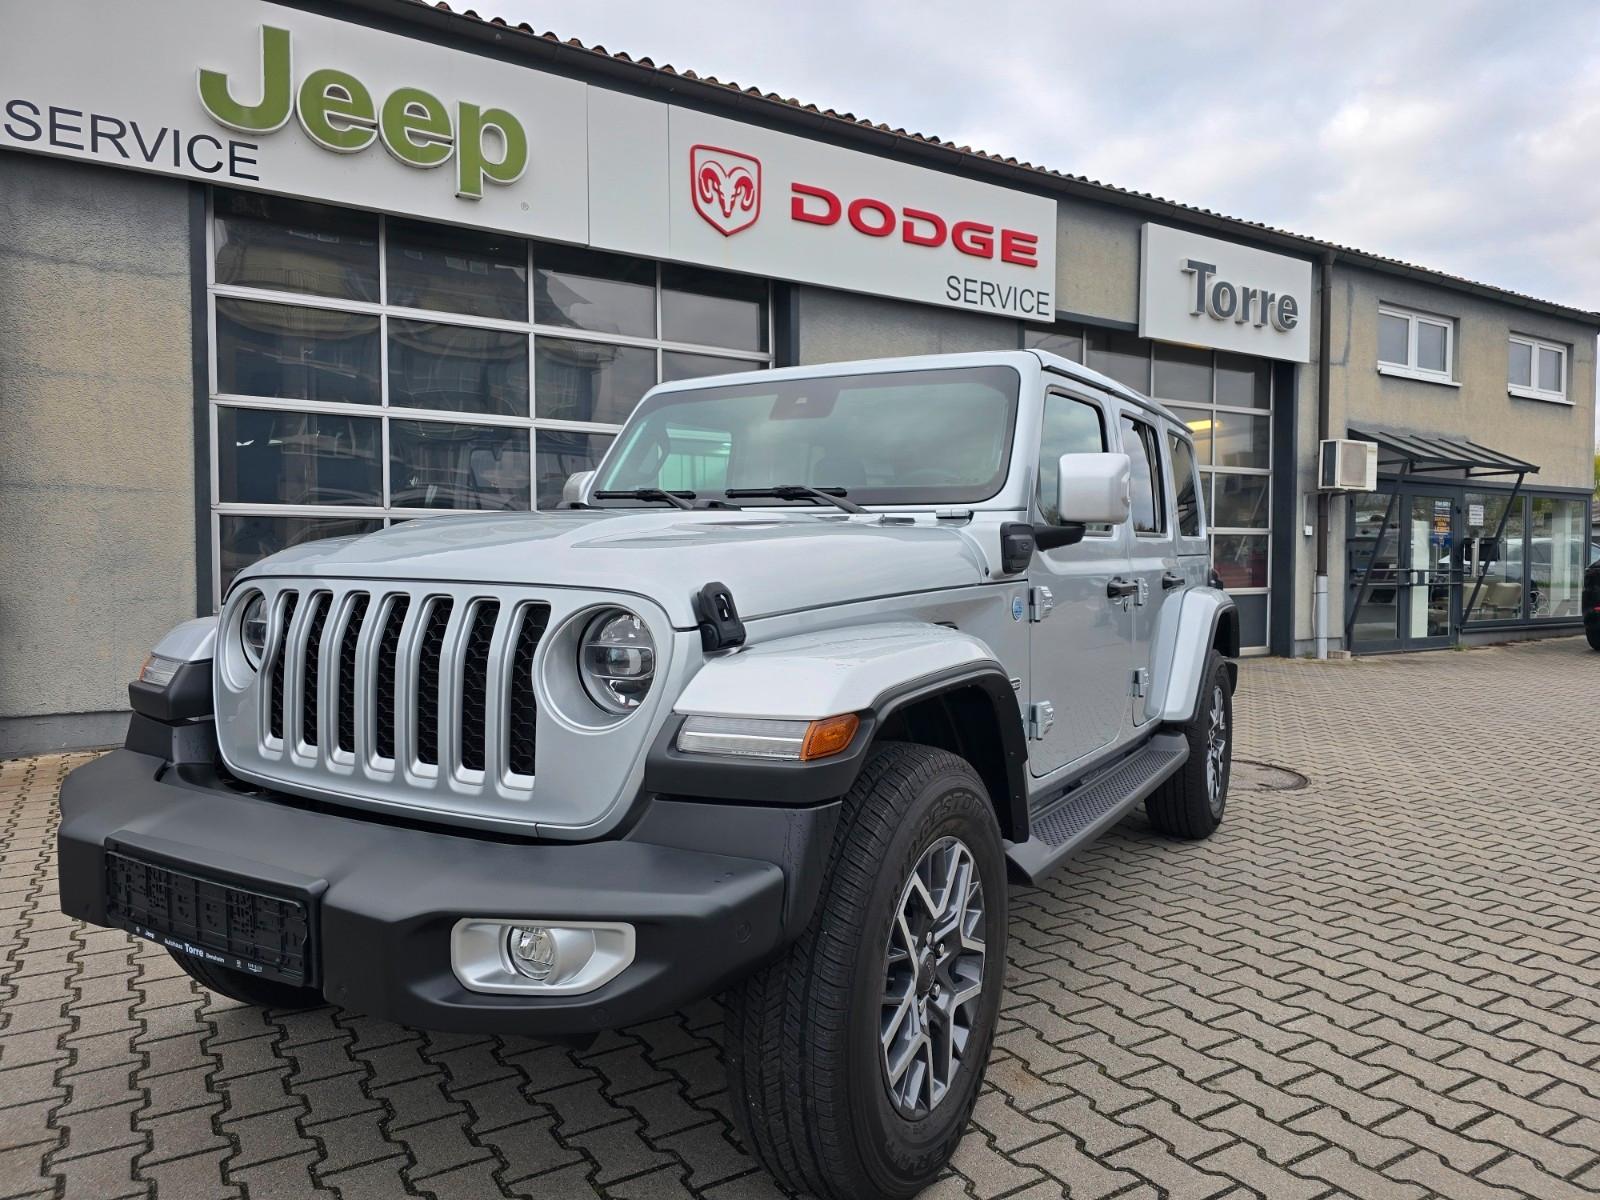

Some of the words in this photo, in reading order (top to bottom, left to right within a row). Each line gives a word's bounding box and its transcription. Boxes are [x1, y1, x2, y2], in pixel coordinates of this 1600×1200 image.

[3, 99, 260, 182] SERVICE
[196, 24, 528, 201] Jeep
[791, 182, 1038, 268] DODGE
[946, 275, 1050, 316] SERVICE
[1181, 258, 1299, 332] Torre
[184, 943, 204, 957] Torre
